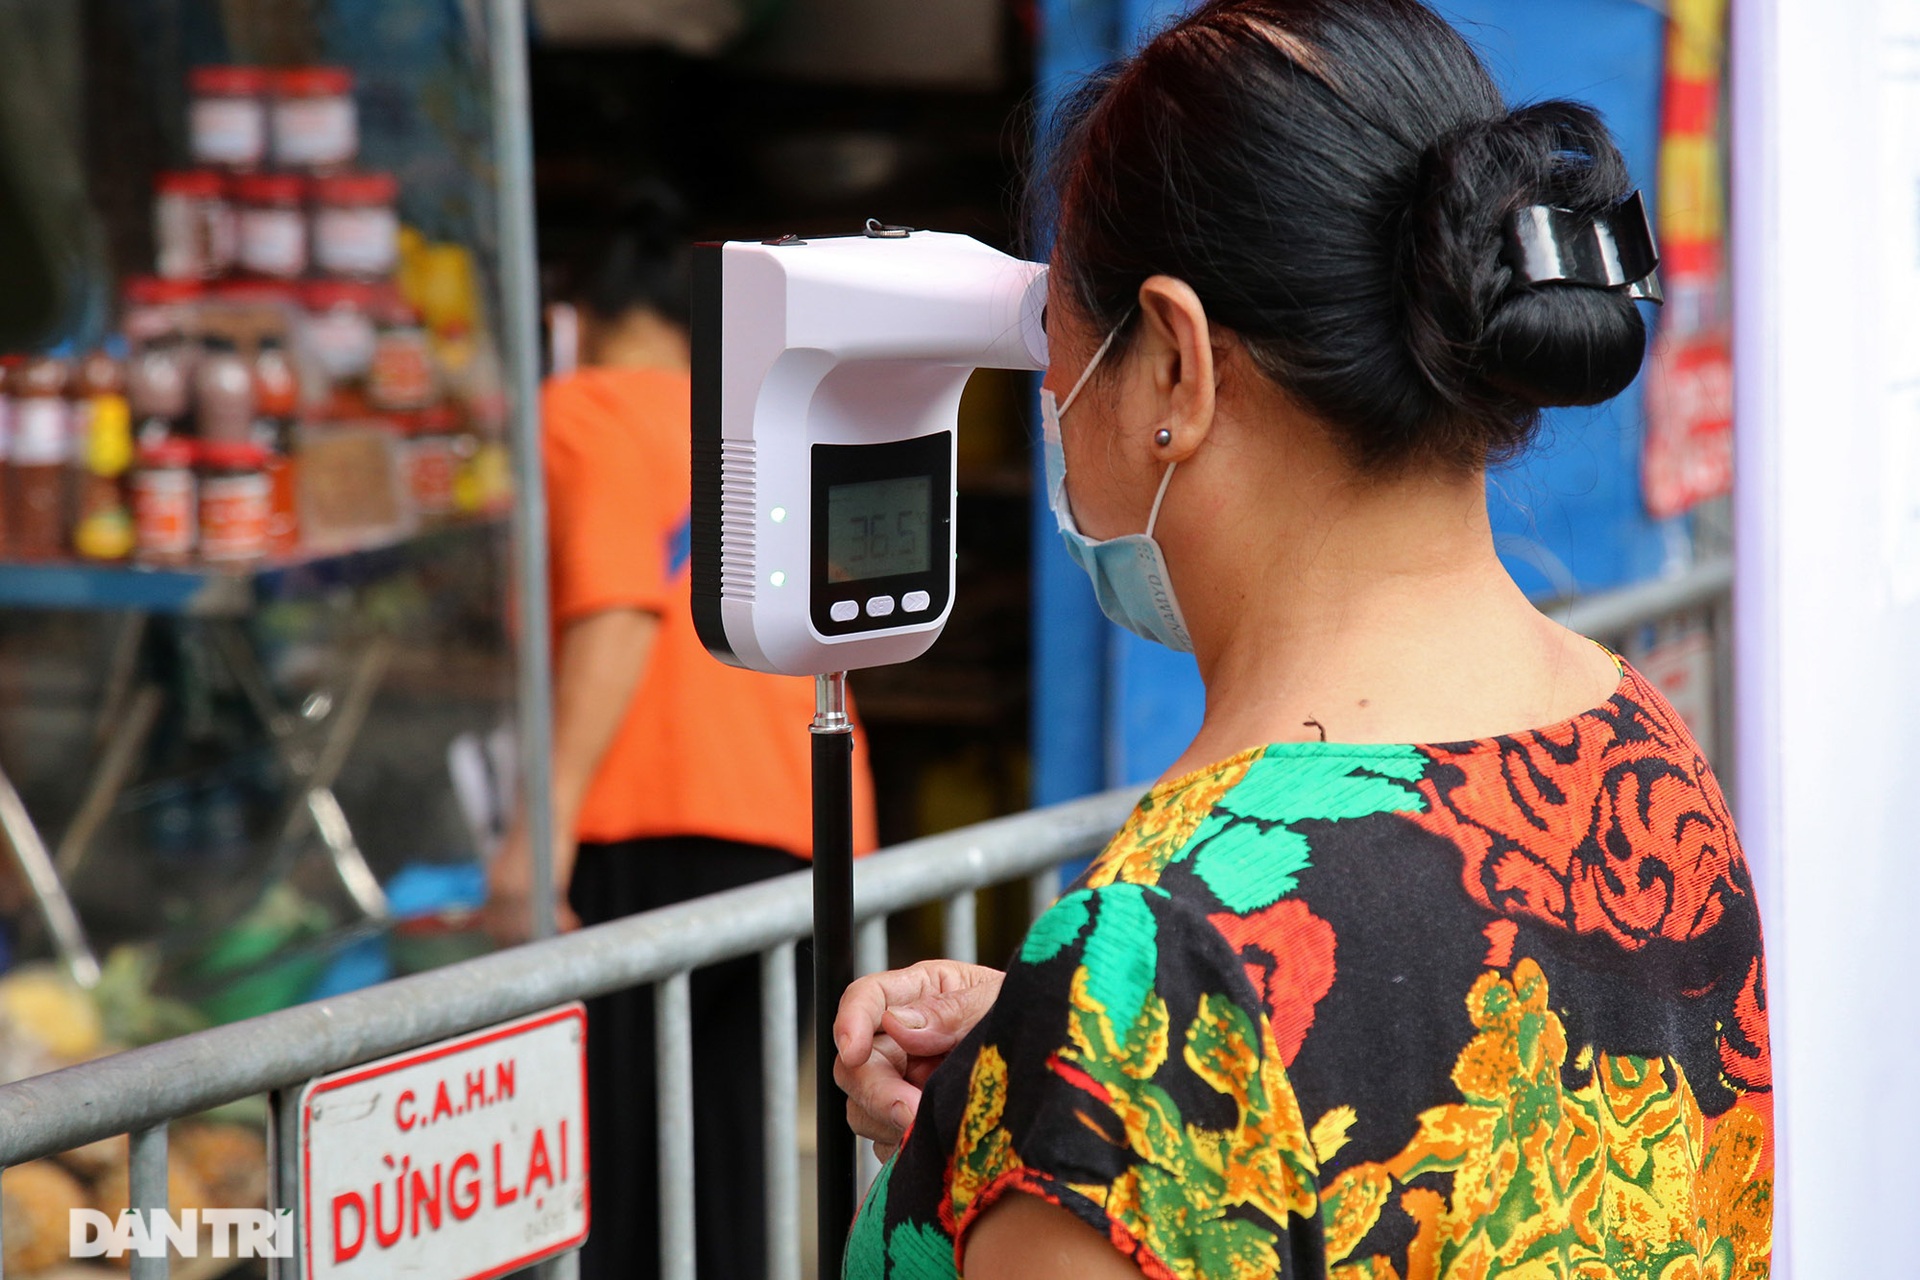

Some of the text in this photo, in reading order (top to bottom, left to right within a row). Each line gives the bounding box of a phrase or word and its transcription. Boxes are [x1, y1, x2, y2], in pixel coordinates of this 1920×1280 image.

[395, 1058, 515, 1131] C.A.H.N
[332, 1117, 567, 1264] DỪNG LẠI
